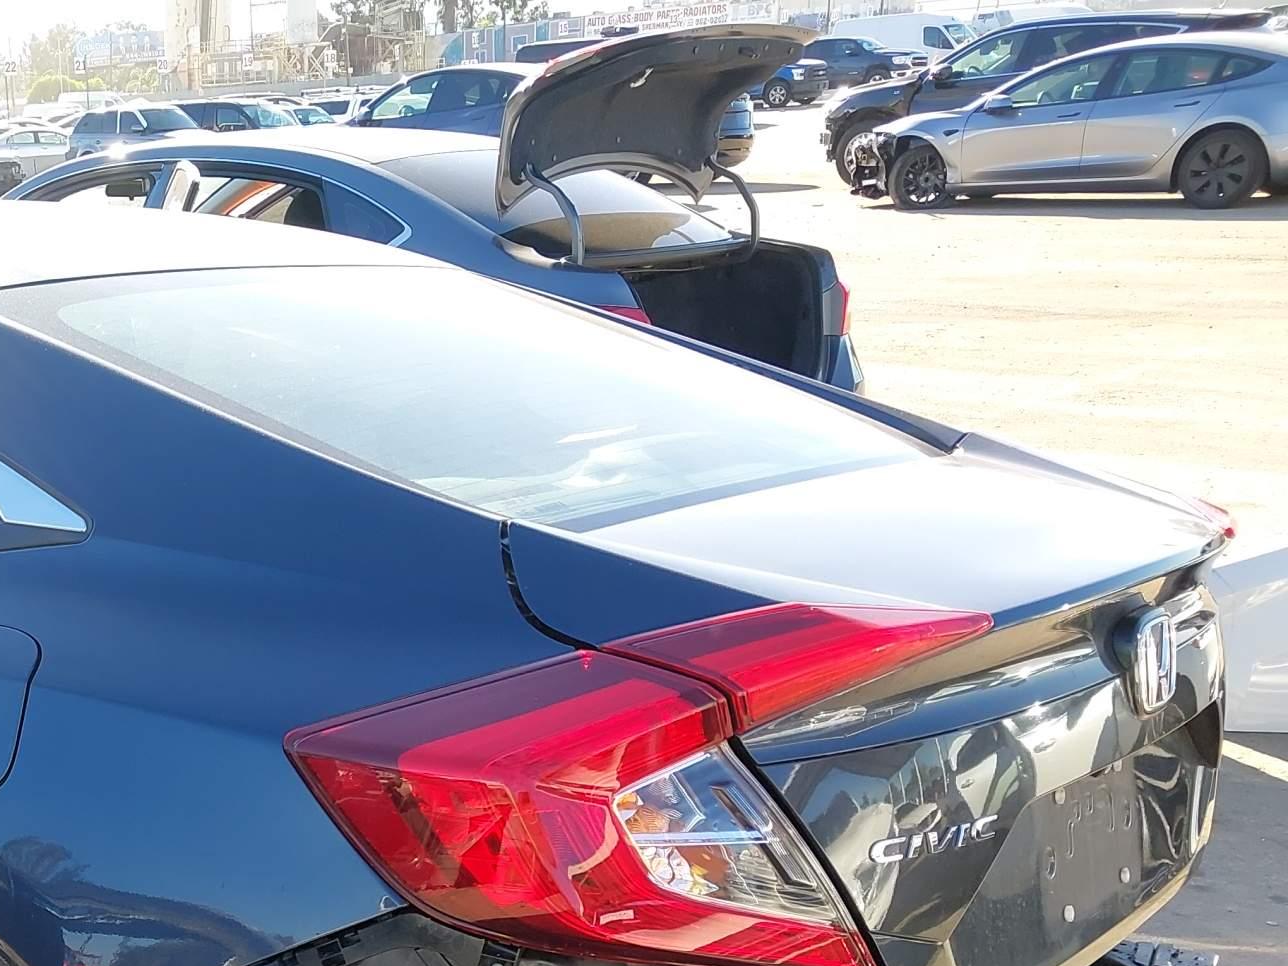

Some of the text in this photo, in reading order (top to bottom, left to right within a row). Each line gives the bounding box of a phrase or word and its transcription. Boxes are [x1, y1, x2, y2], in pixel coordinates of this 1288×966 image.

[588, 16, 606, 27] AUTO
[559, 23, 568, 33] 15
[243, 56, 253, 66] 19
[325, 53, 336, 63] 18
[4, 62, 17, 73] 22
[869, 814, 999, 863] CIVIC
